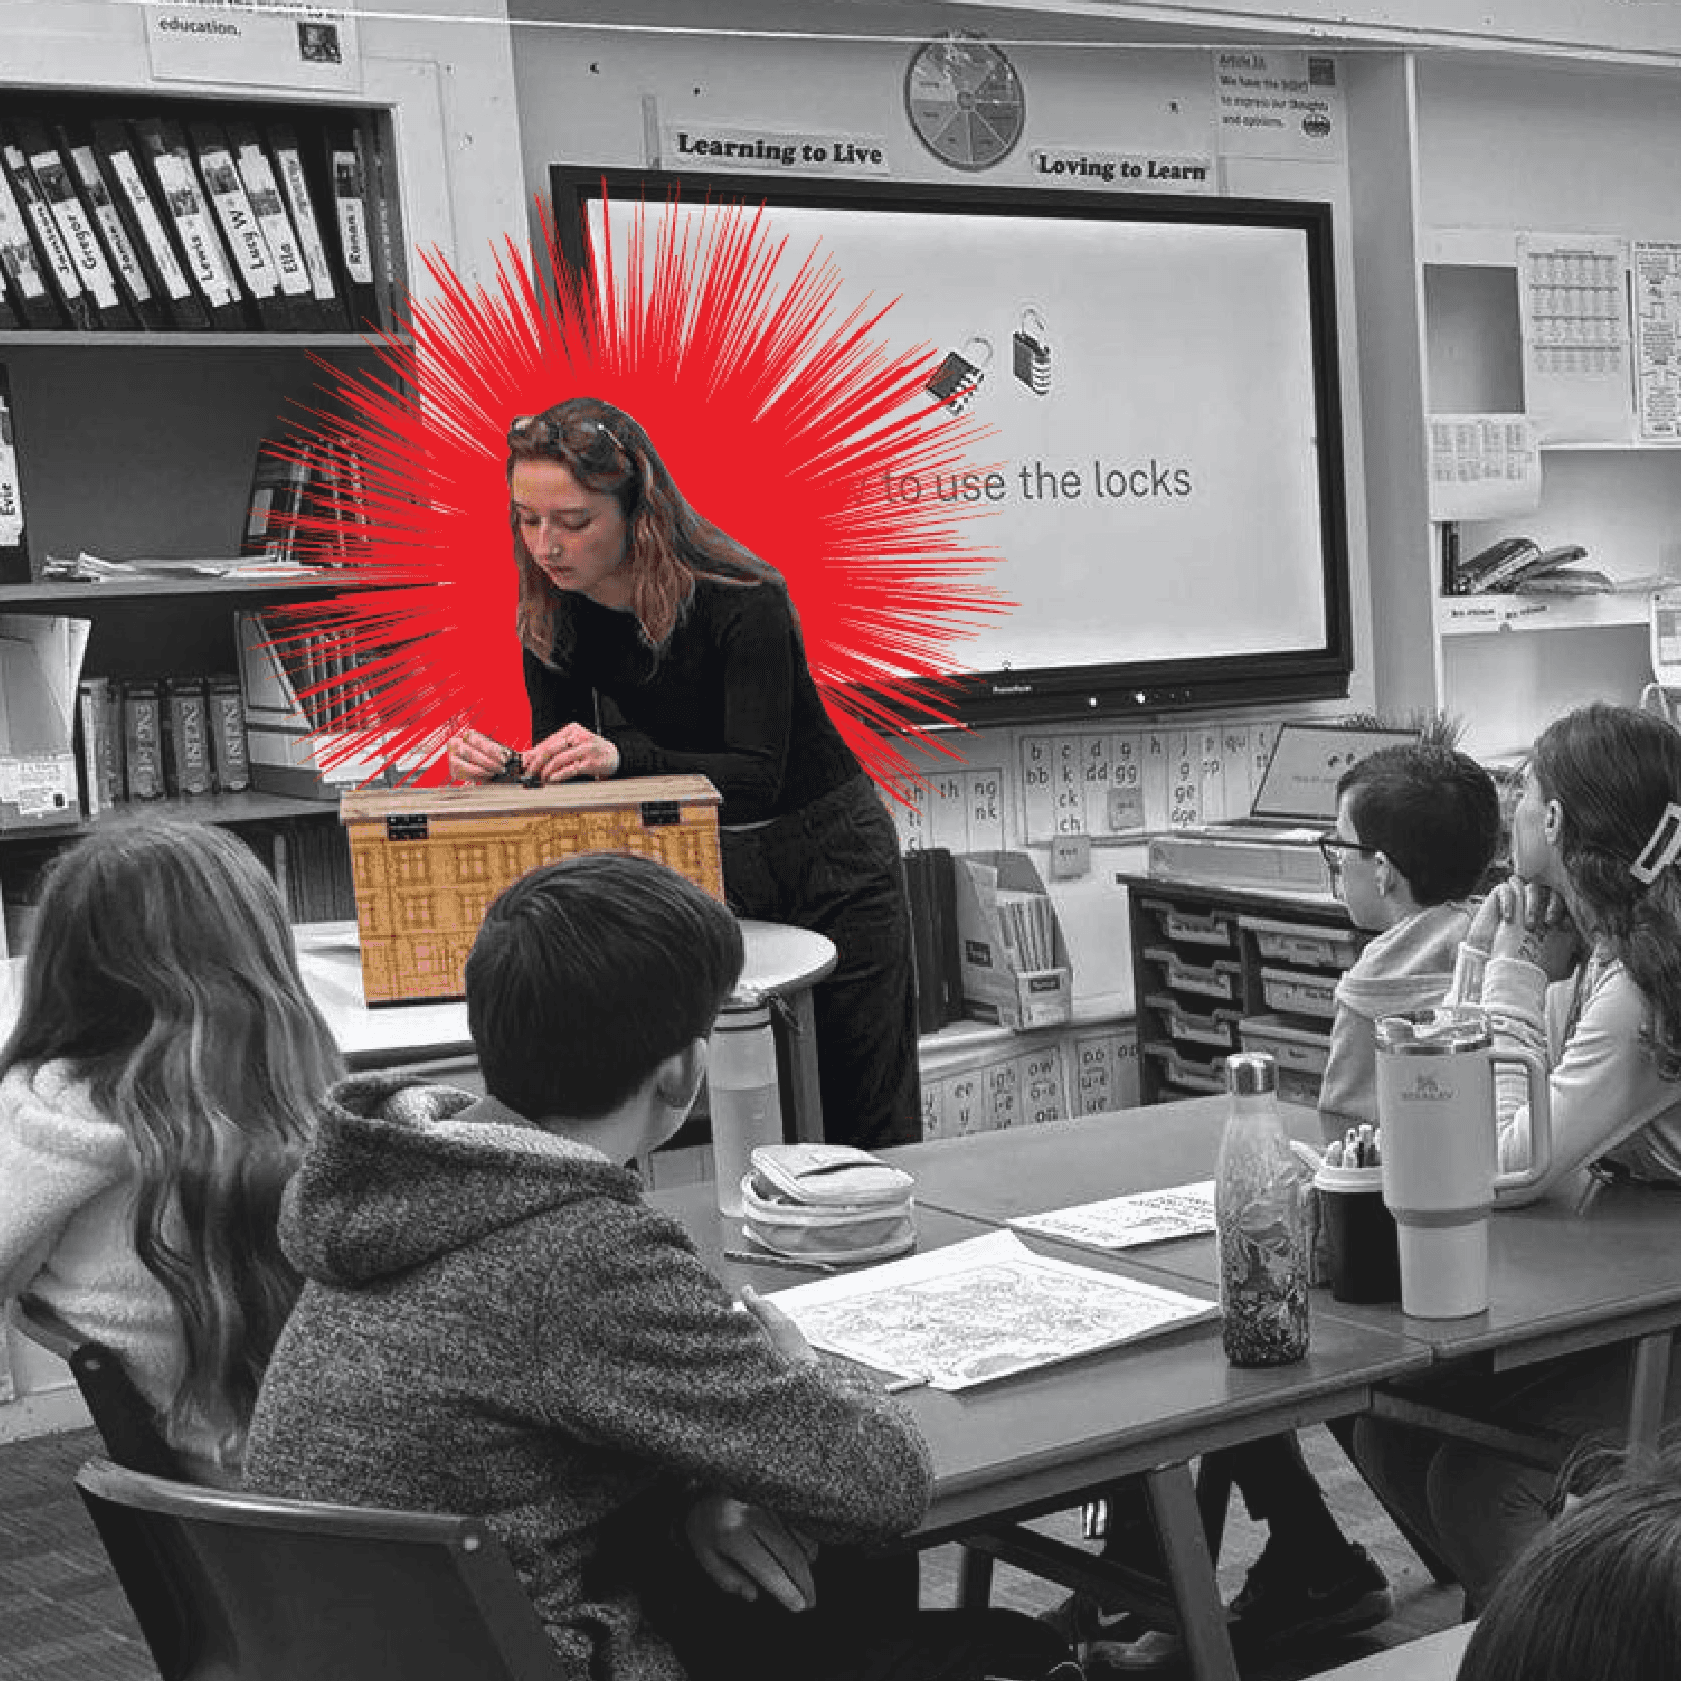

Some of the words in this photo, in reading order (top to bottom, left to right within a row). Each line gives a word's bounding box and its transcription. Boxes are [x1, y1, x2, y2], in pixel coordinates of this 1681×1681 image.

[159, 16, 241, 37] education.
[677, 133, 796, 165] Learning
[802, 141, 826, 162] to
[833, 143, 882, 165] Live
[1039, 154, 1114, 183] Loving
[1120, 158, 1142, 178] to
[1148, 160, 1206, 180] Learn
[229, 208, 247, 231] W
[66, 213, 97, 271] Gregor
[244, 230, 266, 271] Lucy
[191, 234, 214, 283] Lewis
[936, 470, 1006, 501] use
[1018, 460, 1081, 500] the
[1094, 458, 1192, 498] locks
[1031, 743, 1043, 761] b
[1062, 744, 1072, 759] c
[1091, 741, 1102, 758] d
[1150, 736, 1161, 754] h
[1027, 766, 1049, 785] bb
[1087, 762, 1107, 782] dd
[1058, 813, 1081, 833] ch
